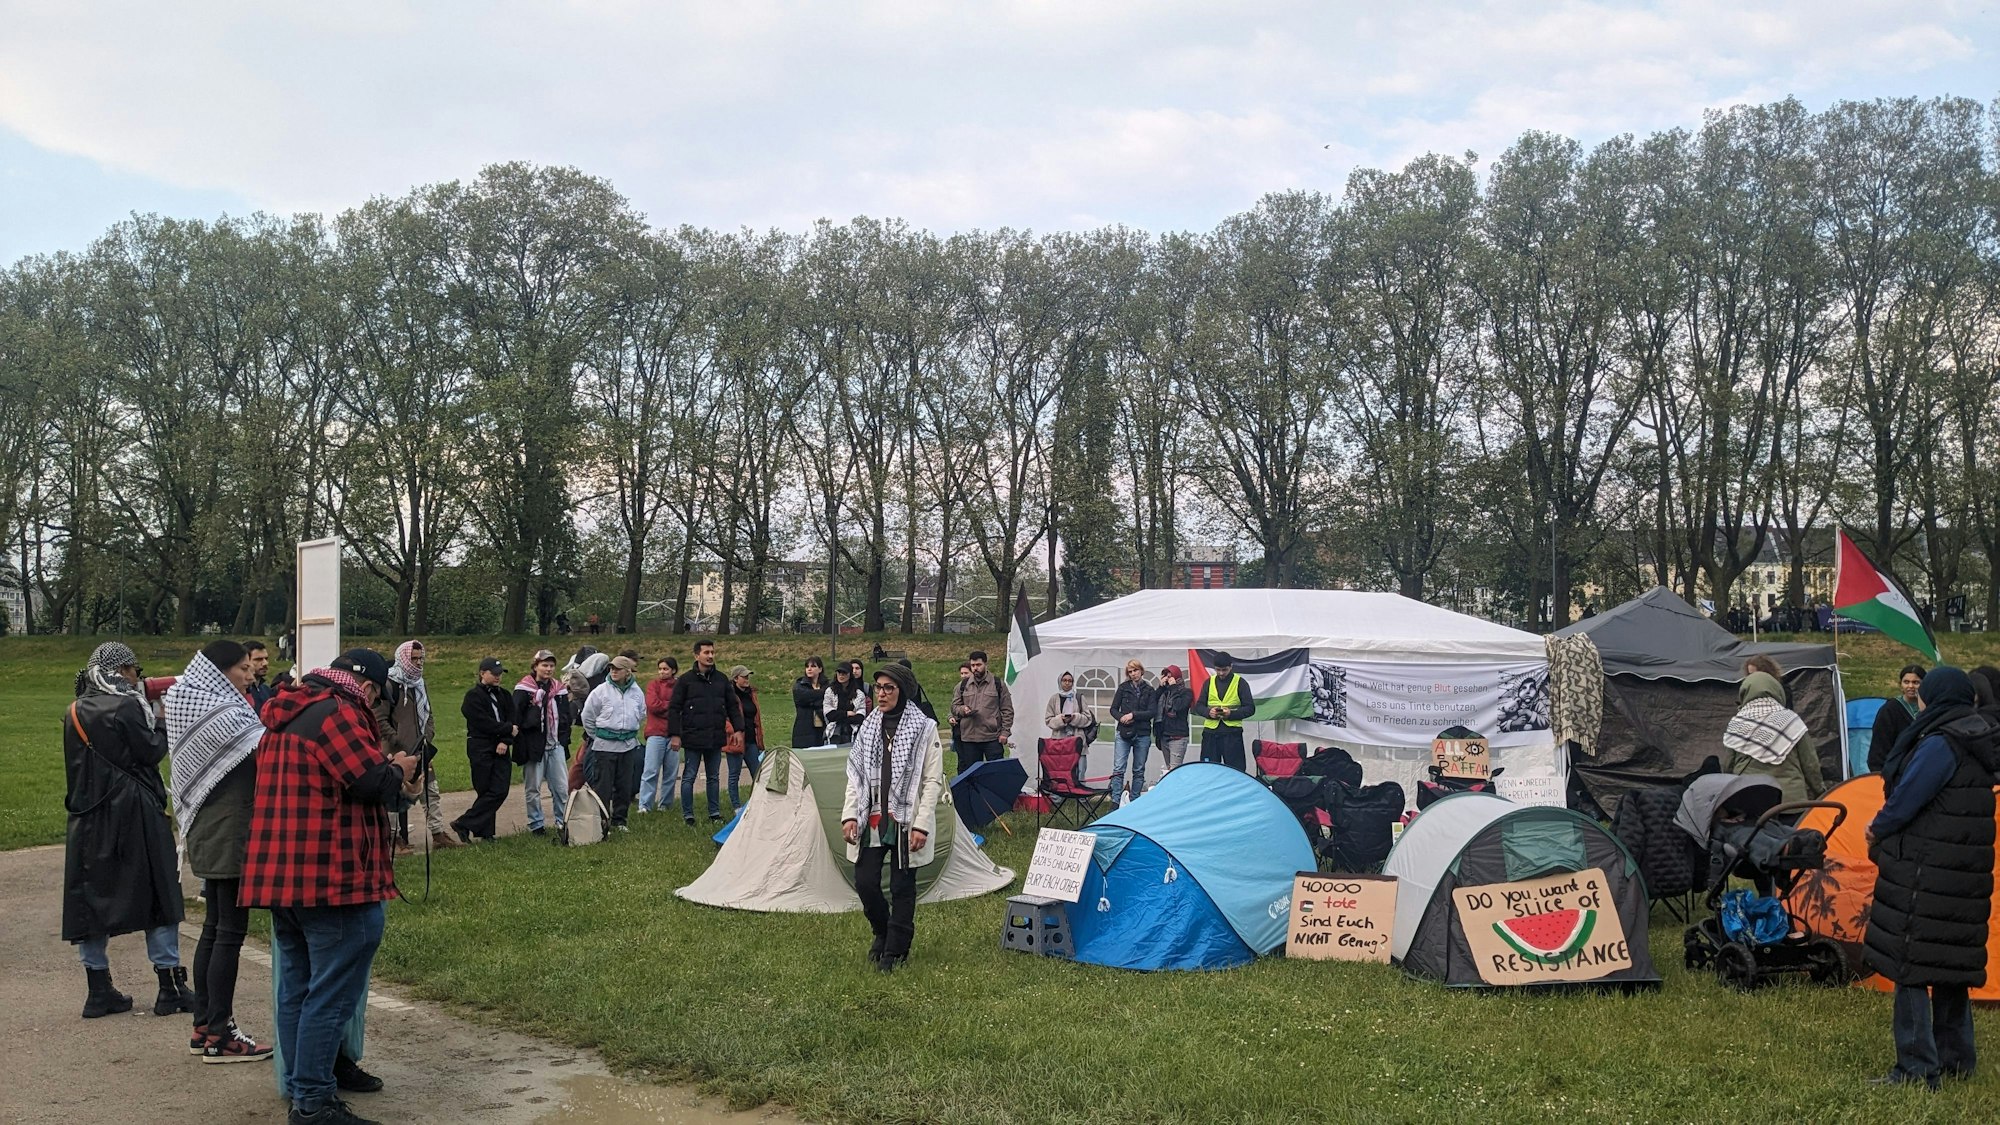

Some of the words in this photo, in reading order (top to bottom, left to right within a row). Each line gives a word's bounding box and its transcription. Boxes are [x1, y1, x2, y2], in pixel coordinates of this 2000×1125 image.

[1370, 681, 1388, 691] Welt
[1391, 683, 1404, 691] hat
[1408, 684, 1432, 694] genug
[1434, 684, 1451, 692] Blut
[1366, 700, 1386, 708] Lass
[1409, 702, 1430, 710] Tinte
[1434, 702, 1478, 712] benutzen,
[1384, 716, 1416, 725] Frieden
[1420, 718, 1430, 726] zu
[1432, 716, 1478, 726] schreiben.
[1435, 740, 1464, 756] ALL
[1439, 760, 1488, 776] RAFFAH
[1497, 780, 1516, 788] WENN
[1523, 778, 1551, 786] UNRECHT
[1513, 790, 1532, 799] RECHT
[1540, 789, 1558, 798] WIRD
[1038, 830, 1050, 840] WE
[1050, 831, 1060, 842] WILL
[1060, 832, 1078, 844] NEVER
[1078, 834, 1095, 846] FORGET
[1037, 843, 1053, 854] THAT
[1055, 845, 1066, 856] YOU
[1069, 847, 1084, 860] LET
[1052, 858, 1082, 873] CHILDREN
[1026, 872, 1044, 886] BURY
[1042, 874, 1060, 889] EACH
[1060, 878, 1080, 894] OTHER
[1302, 881, 1361, 894] 40000
[1466, 892, 1492, 910] DO
[1540, 878, 1580, 898] want
[1586, 880, 1599, 892] a
[1323, 896, 1356, 908] tote
[1336, 915, 1374, 929] Euch
[1294, 932, 1332, 945] NICHT
[1492, 940, 1630, 972] RESISTANCE
